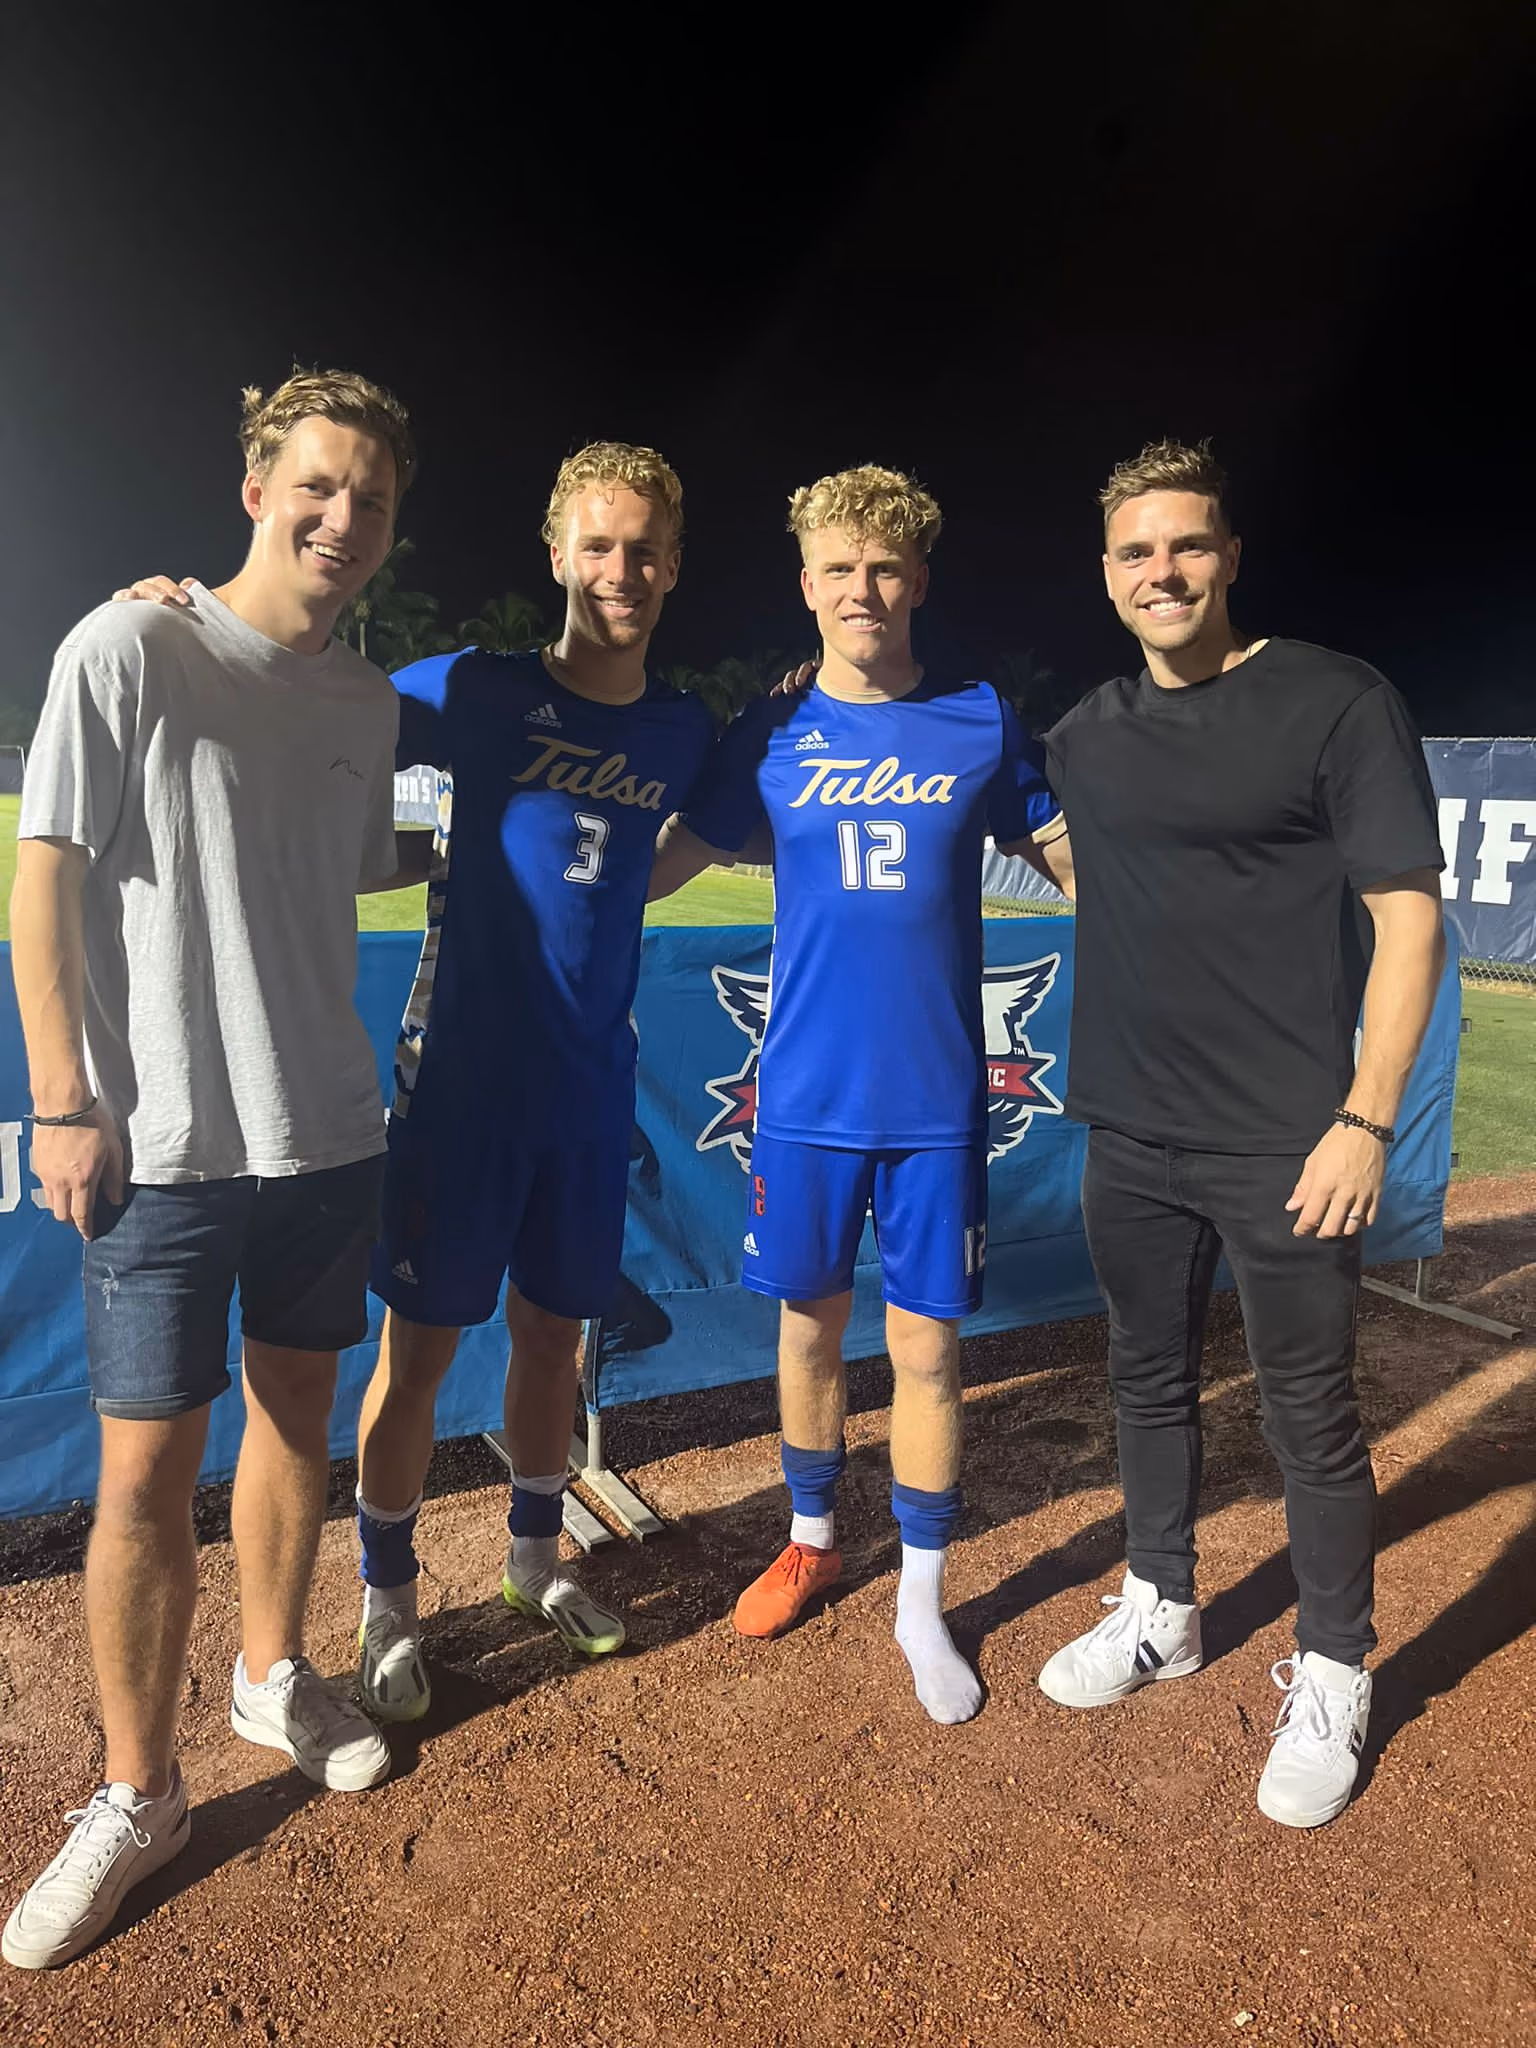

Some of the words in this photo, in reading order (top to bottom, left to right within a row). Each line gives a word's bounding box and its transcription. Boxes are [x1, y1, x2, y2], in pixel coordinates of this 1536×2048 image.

[509, 735, 667, 812] Tulsa
[795, 741, 830, 751] adidas
[787, 756, 959, 809] Tulsa
[563, 812, 610, 885] 3
[837, 820, 907, 891] 12
